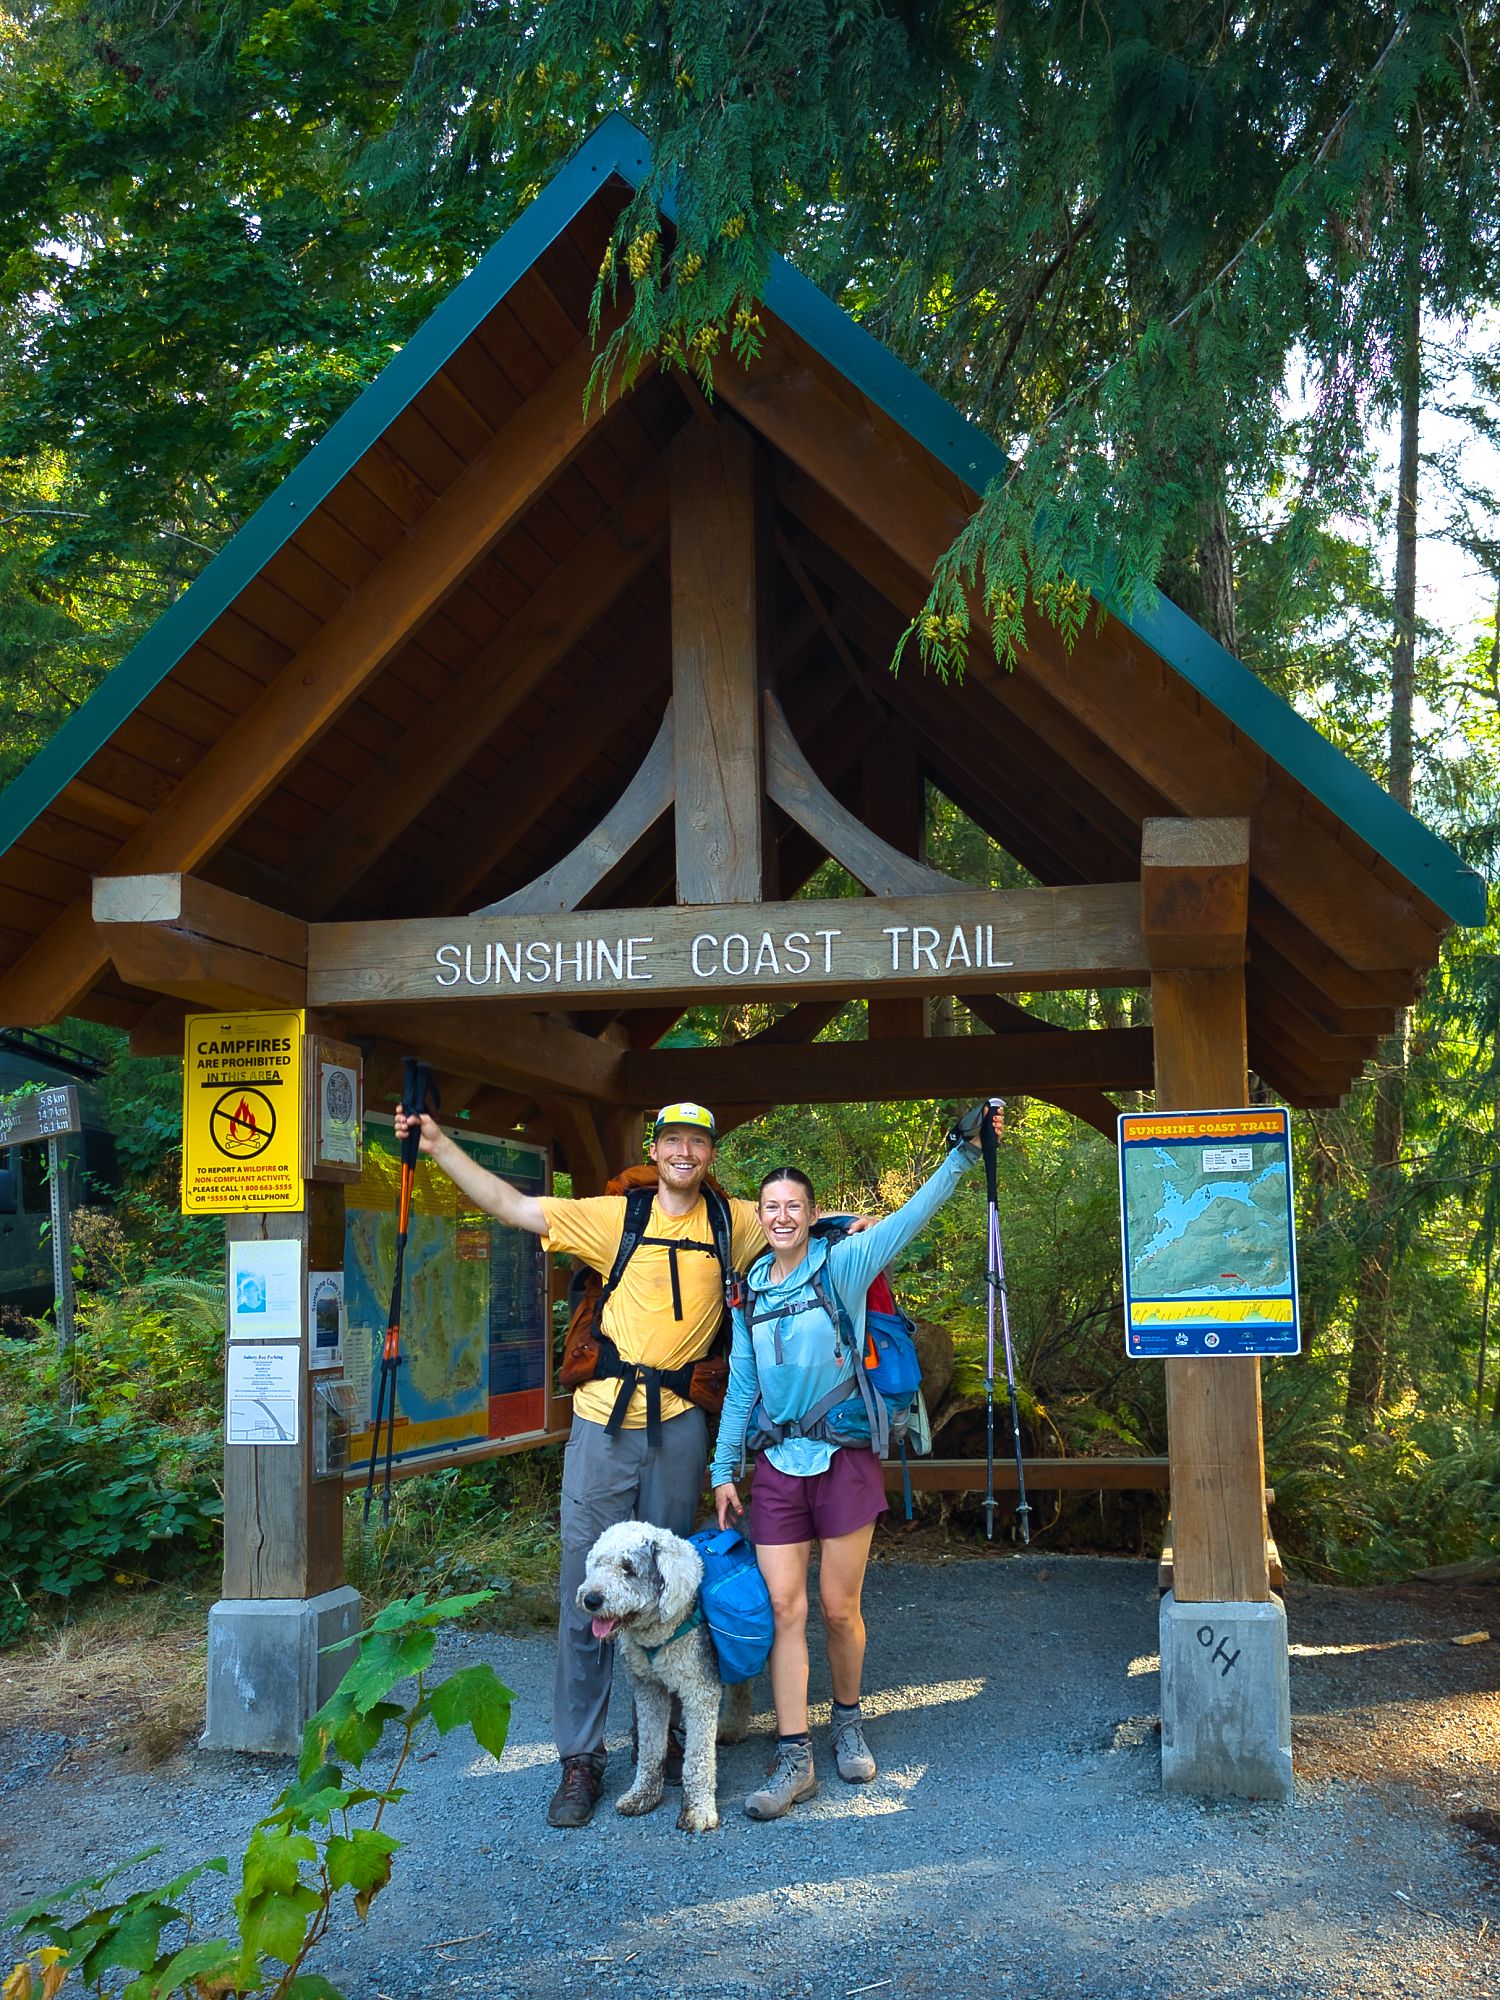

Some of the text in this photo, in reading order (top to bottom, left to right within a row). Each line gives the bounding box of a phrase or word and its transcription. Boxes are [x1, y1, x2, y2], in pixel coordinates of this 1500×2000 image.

[435, 925, 1014, 986] SUNSHINE COAST TRAIL
[197, 1038, 291, 1055] CAMPFIRES
[197, 1056, 291, 1069] ARE PROHIBITED
[207, 1070, 280, 1082] IN THIS AREA
[40, 1093, 66, 1107] 5.8 km
[38, 1108, 54, 1121] 14.7
[55, 1106, 67, 1117] km
[39, 1121, 55, 1134] 16.1
[56, 1120, 69, 1130] km
[1128, 1121, 1279, 1136] SUNSHINE COAST TRAIL
[473, 1148, 495, 1166] Coast
[243, 1165, 277, 1173] WILDFIRE
[259, 1183, 292, 1191] 663-5555
[248, 1193, 290, 1201] CELLPHONE
[311, 1281, 326, 1312] Sunshine
